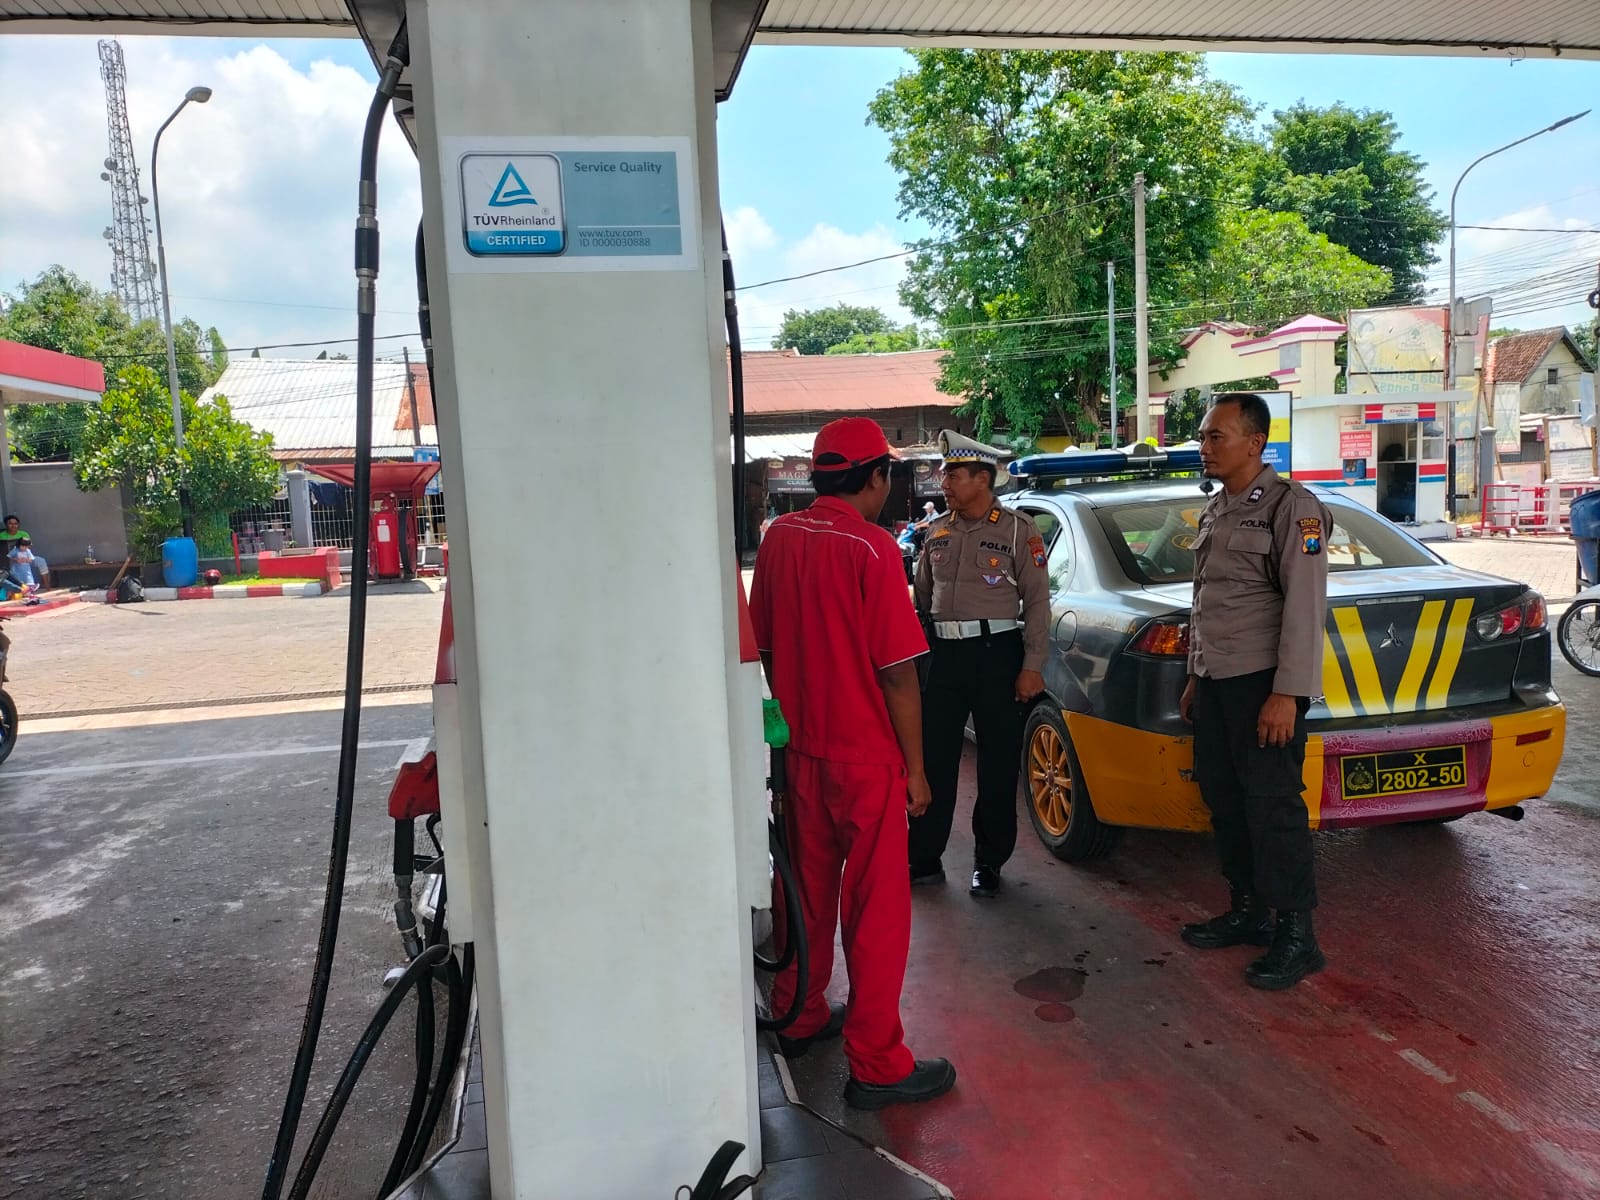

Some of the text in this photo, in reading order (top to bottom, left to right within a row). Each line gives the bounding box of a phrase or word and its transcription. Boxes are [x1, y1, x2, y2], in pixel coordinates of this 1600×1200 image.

[574, 161, 662, 175] Service Quality
[486, 235, 547, 246] CERTIFIED
[578, 229, 643, 239] www.tuv.com
[579, 238, 590, 248] ID
[979, 540, 1012, 554] POLRI
[1414, 752, 1427, 765] X
[1381, 765, 1462, 791] 2802-50
